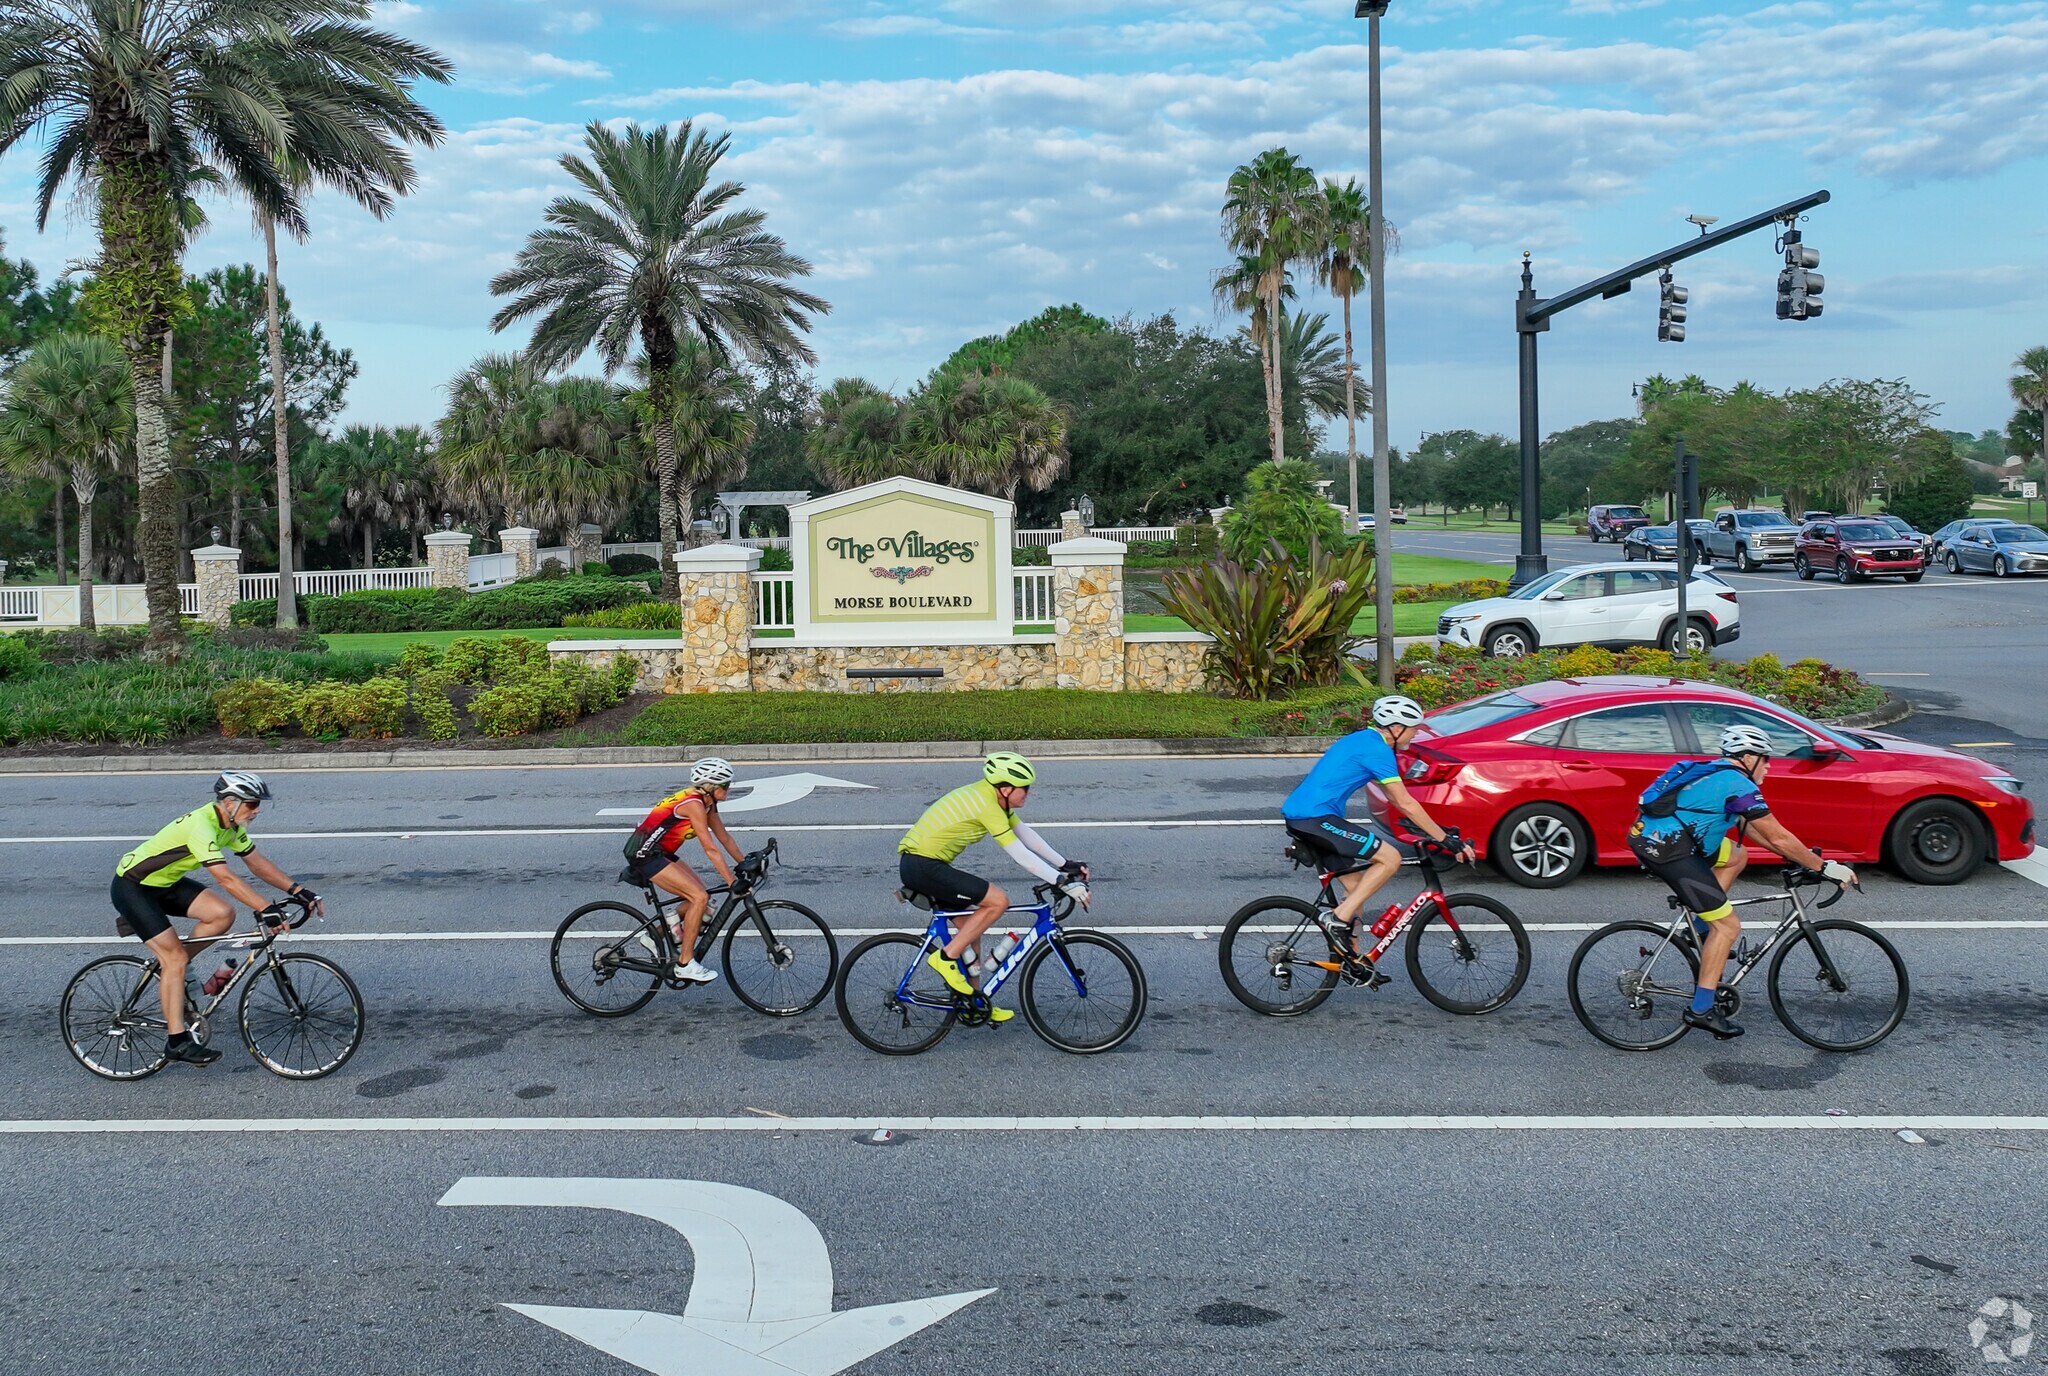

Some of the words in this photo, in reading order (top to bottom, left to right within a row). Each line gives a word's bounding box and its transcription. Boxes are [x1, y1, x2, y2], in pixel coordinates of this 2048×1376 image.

[826, 537, 875, 564] The
[834, 597, 884, 609] MORSE
[889, 595, 973, 608] BOULEVARD
[1377, 895, 1427, 953] PINARELLO
[982, 927, 1039, 997] FUJI
